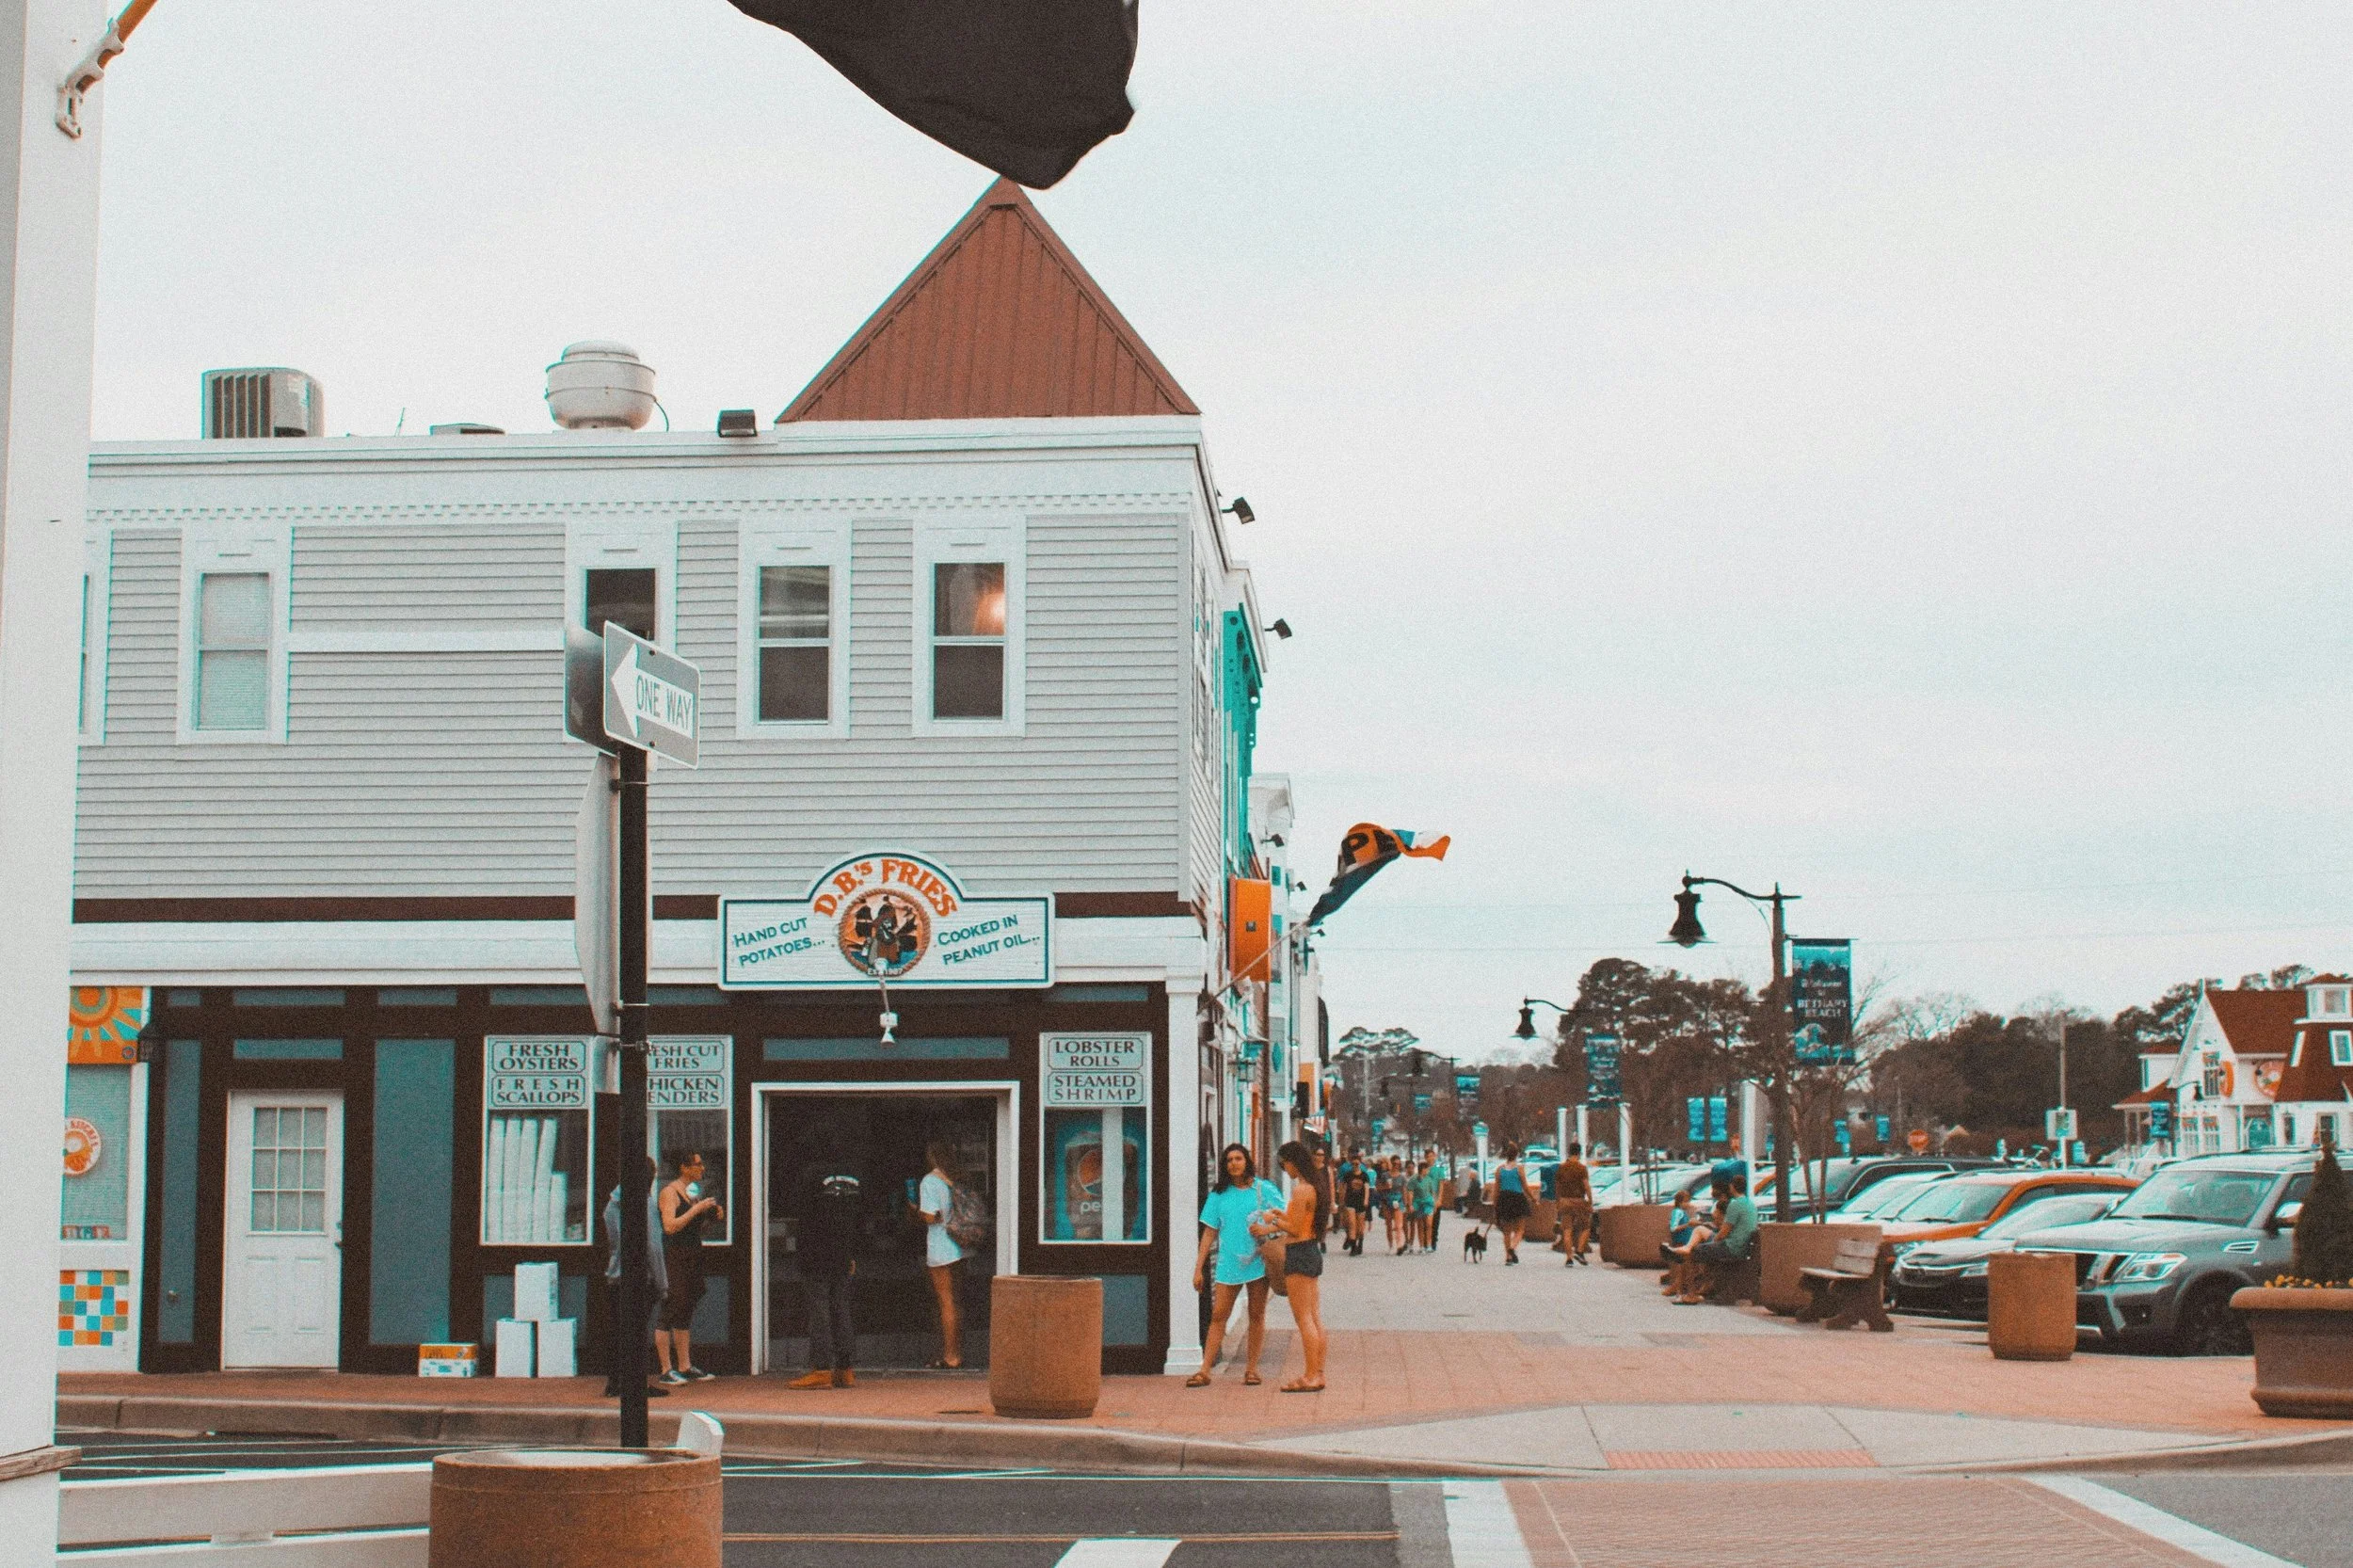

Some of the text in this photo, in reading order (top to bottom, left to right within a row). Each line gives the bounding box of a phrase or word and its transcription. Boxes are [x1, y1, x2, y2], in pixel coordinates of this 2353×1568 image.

[635, 675, 692, 730] ONE WAY
[881, 858, 958, 918] FRIES
[733, 917, 808, 948] HAND CUT
[937, 914, 1018, 946] COOKED IN
[942, 939, 1000, 966] PEANUT
[509, 1044, 570, 1057] FRESH
[649, 1045, 719, 1057] ESH CUT
[1055, 1040, 1135, 1054] LOBSTER
[500, 1057, 579, 1070] OYSTERS
[655, 1057, 700, 1069] FRIES
[1070, 1055, 1121, 1067] ROLLS
[498, 1078, 580, 1090] FRESH
[648, 1078, 719, 1091] HICKEN
[1054, 1075, 1136, 1088] STEAMED
[496, 1091, 581, 1104] SCALLOPS
[648, 1091, 720, 1104] ENDERS
[1054, 1088, 1137, 1101] SHRIMP
